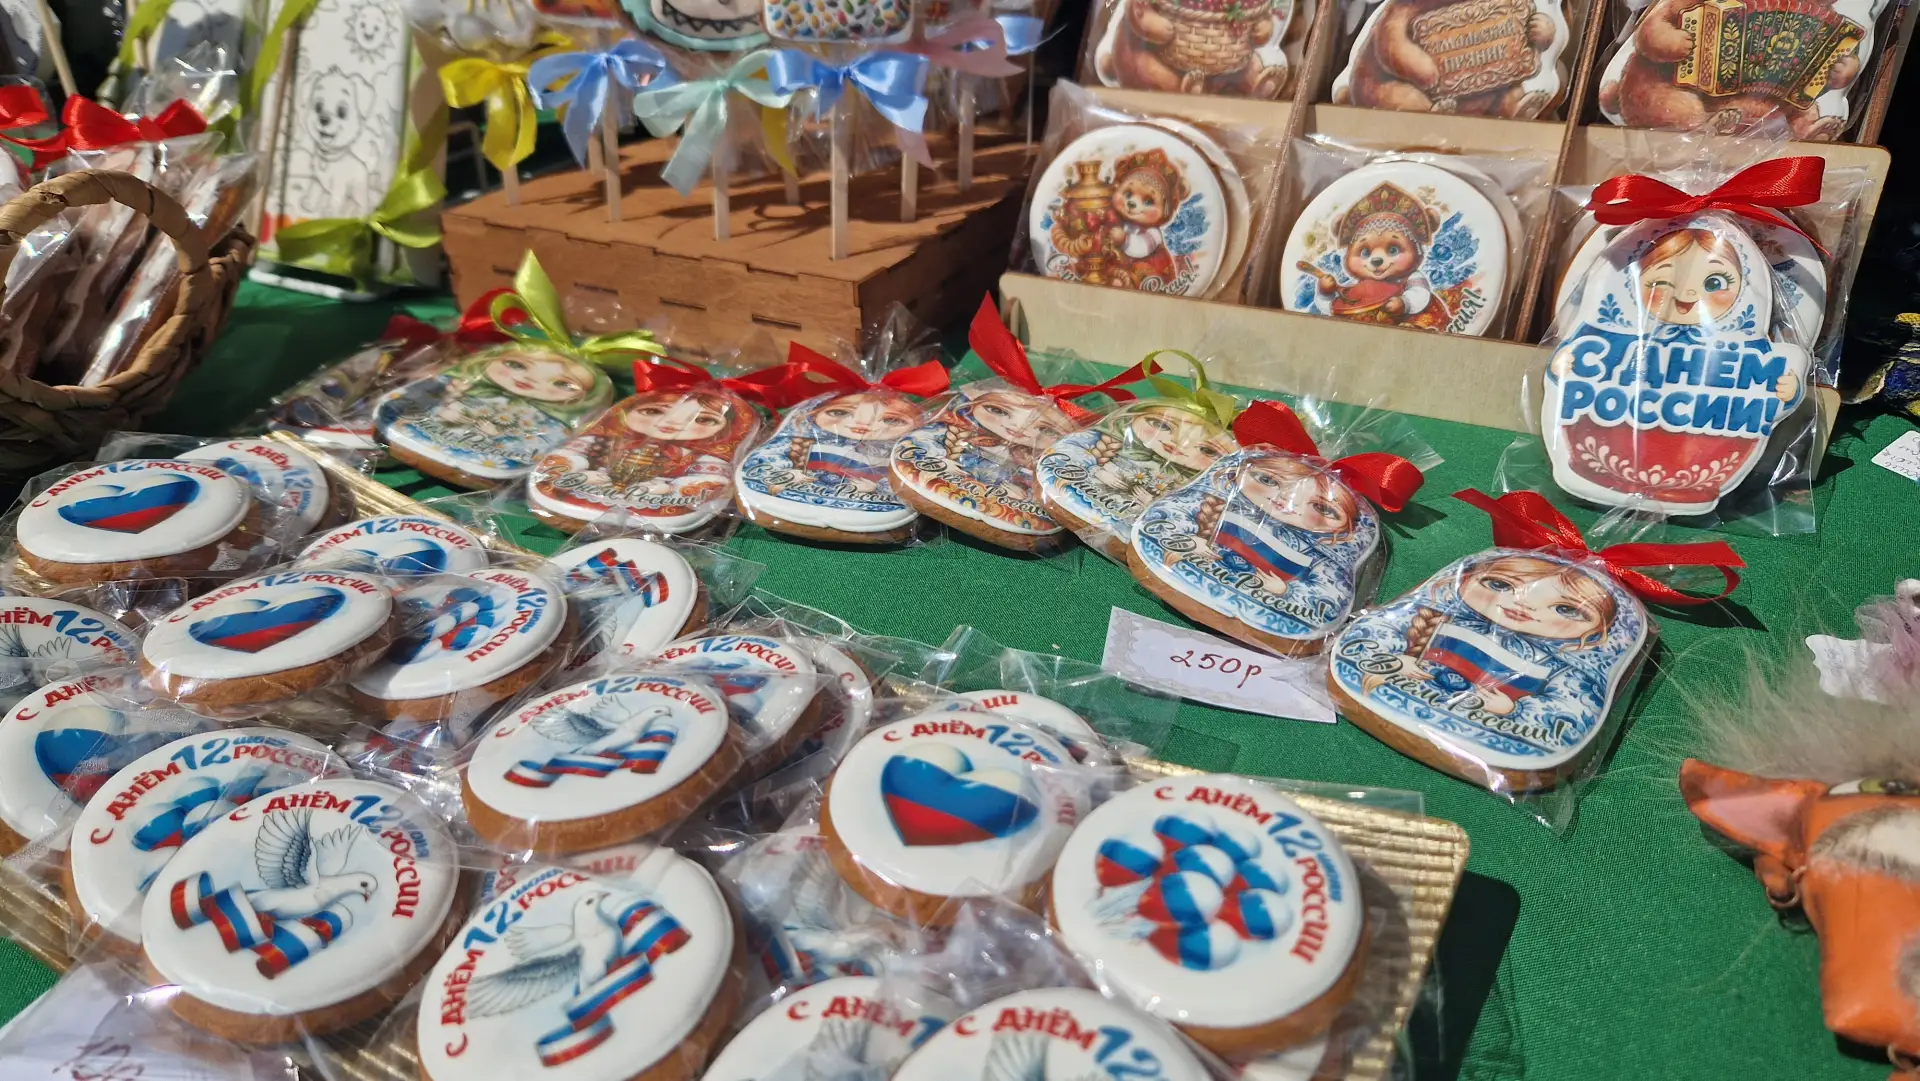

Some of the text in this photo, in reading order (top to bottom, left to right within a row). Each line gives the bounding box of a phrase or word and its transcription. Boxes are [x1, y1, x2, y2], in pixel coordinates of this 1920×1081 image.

[1572, 339, 1787, 393] С ДНЁМ
[1561, 381, 1779, 436] РОССИИ!
[228, 442, 243, 451] С
[1040, 452, 1071, 472] С
[31, 500, 49, 509] С
[102, 460, 145, 474] 12
[146, 461, 227, 481] РОССИИ
[746, 464, 774, 478] С
[834, 482, 894, 503] Росси
[899, 446, 928, 461] С
[983, 484, 1051, 519] Росси
[357, 518, 400, 535] 12
[1143, 520, 1327, 626] С Днём России!
[168, 614, 188, 624] С
[303, 574, 379, 595] РОССИИ
[516, 587, 549, 611] 12
[0, 606, 54, 627] НЁМ
[53, 610, 105, 645] 12
[465, 609, 533, 664] РОССИИ
[696, 635, 741, 653] 12
[16, 707, 40, 721] С
[495, 727, 516, 738] С
[587, 676, 636, 697] 12
[634, 682, 718, 716] РОССИИ
[1341, 638, 1568, 746] С Днём России!
[883, 728, 904, 742] С
[911, 719, 987, 740] ДНЁМ
[984, 724, 1036, 757] 12
[90, 827, 114, 845] С
[106, 761, 183, 821] ДНЁМ
[170, 737, 231, 771] 12
[1154, 785, 1175, 801] С
[1186, 785, 1274, 826] ДНЁМ
[229, 806, 253, 822] С
[263, 790, 353, 815] ДНЁМ
[349, 794, 404, 835] 12
[381, 829, 422, 920] РОССИИ
[1267, 811, 1324, 859] 12
[463, 900, 524, 950] 12
[1289, 855, 1330, 965] РОССИИ
[440, 948, 486, 1026] ДНЁМ
[445, 1031, 469, 1058] С
[787, 1000, 811, 1022] С
[909, 1015, 949, 1048] 1
[953, 1015, 978, 1036] С
[992, 1005, 1099, 1051] ДНЁМ
